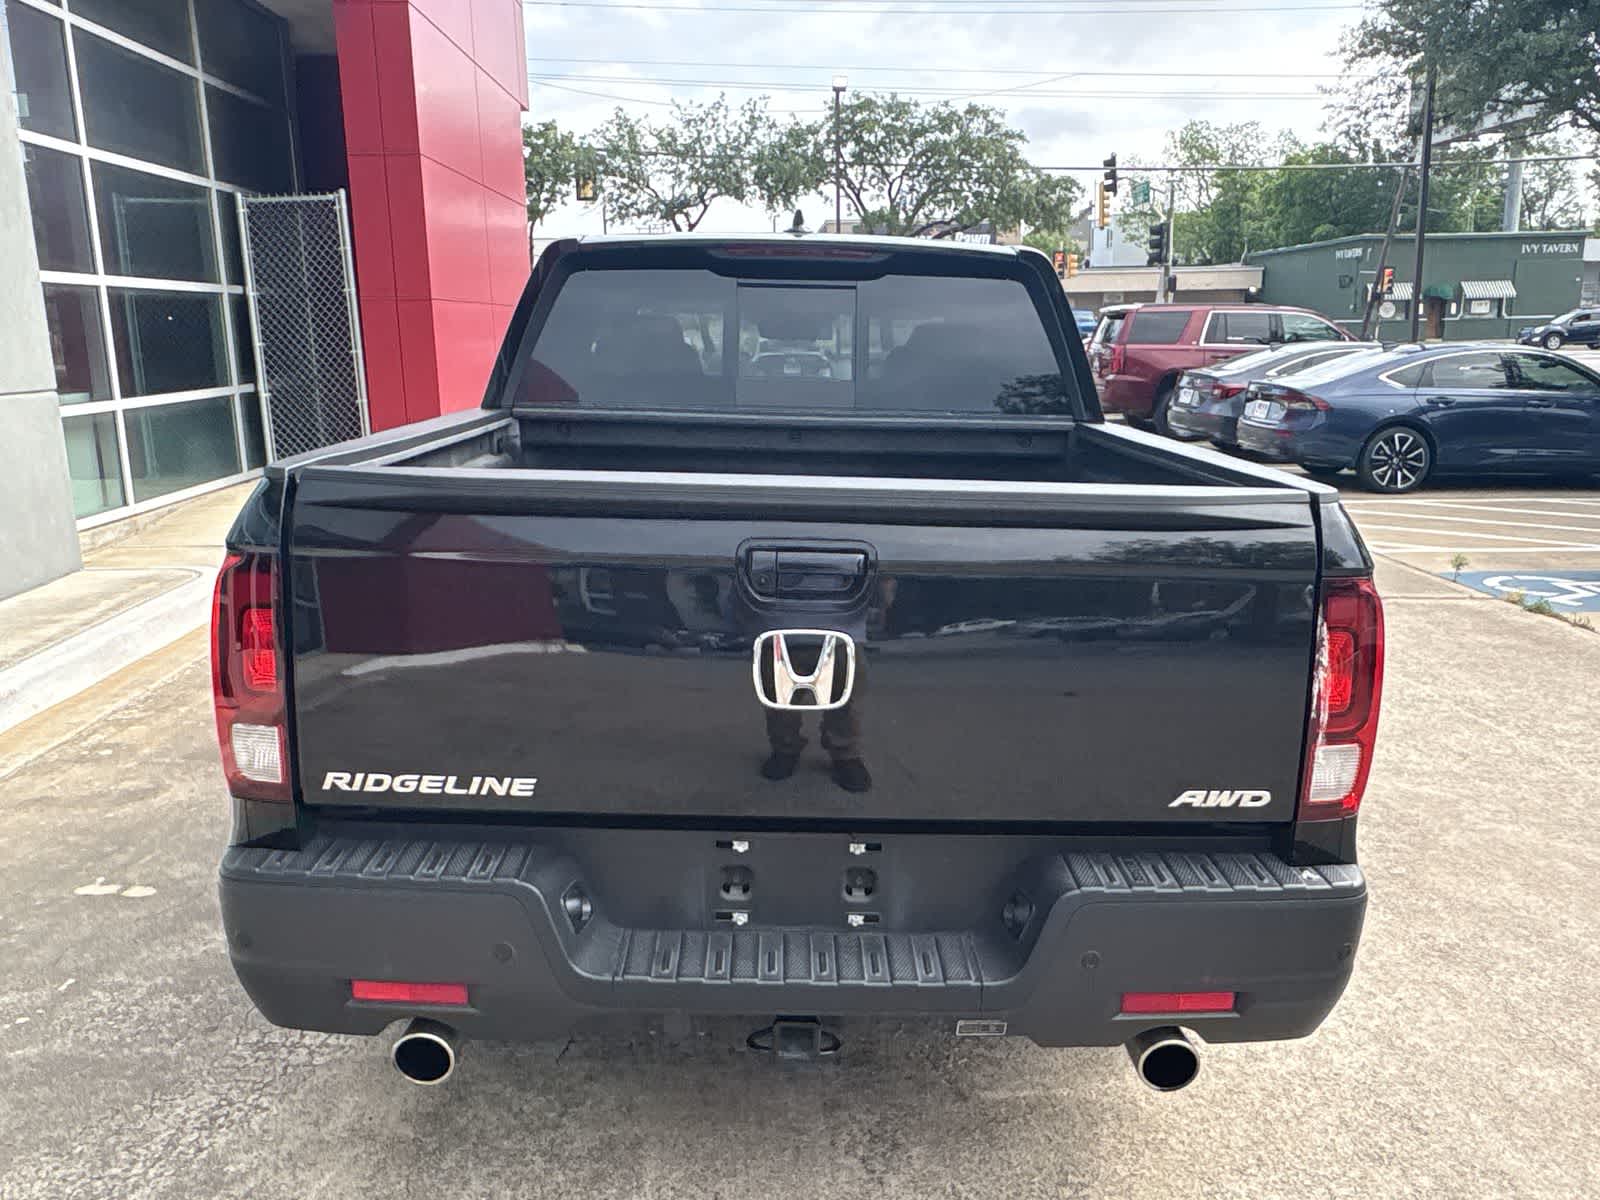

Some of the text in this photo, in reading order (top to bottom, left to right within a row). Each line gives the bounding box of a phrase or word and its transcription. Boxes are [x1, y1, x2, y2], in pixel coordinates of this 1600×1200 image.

[1521, 242, 1579, 254] IVY TAVERN
[321, 771, 538, 797] RIDGELINE
[1167, 790, 1272, 808] AWD
